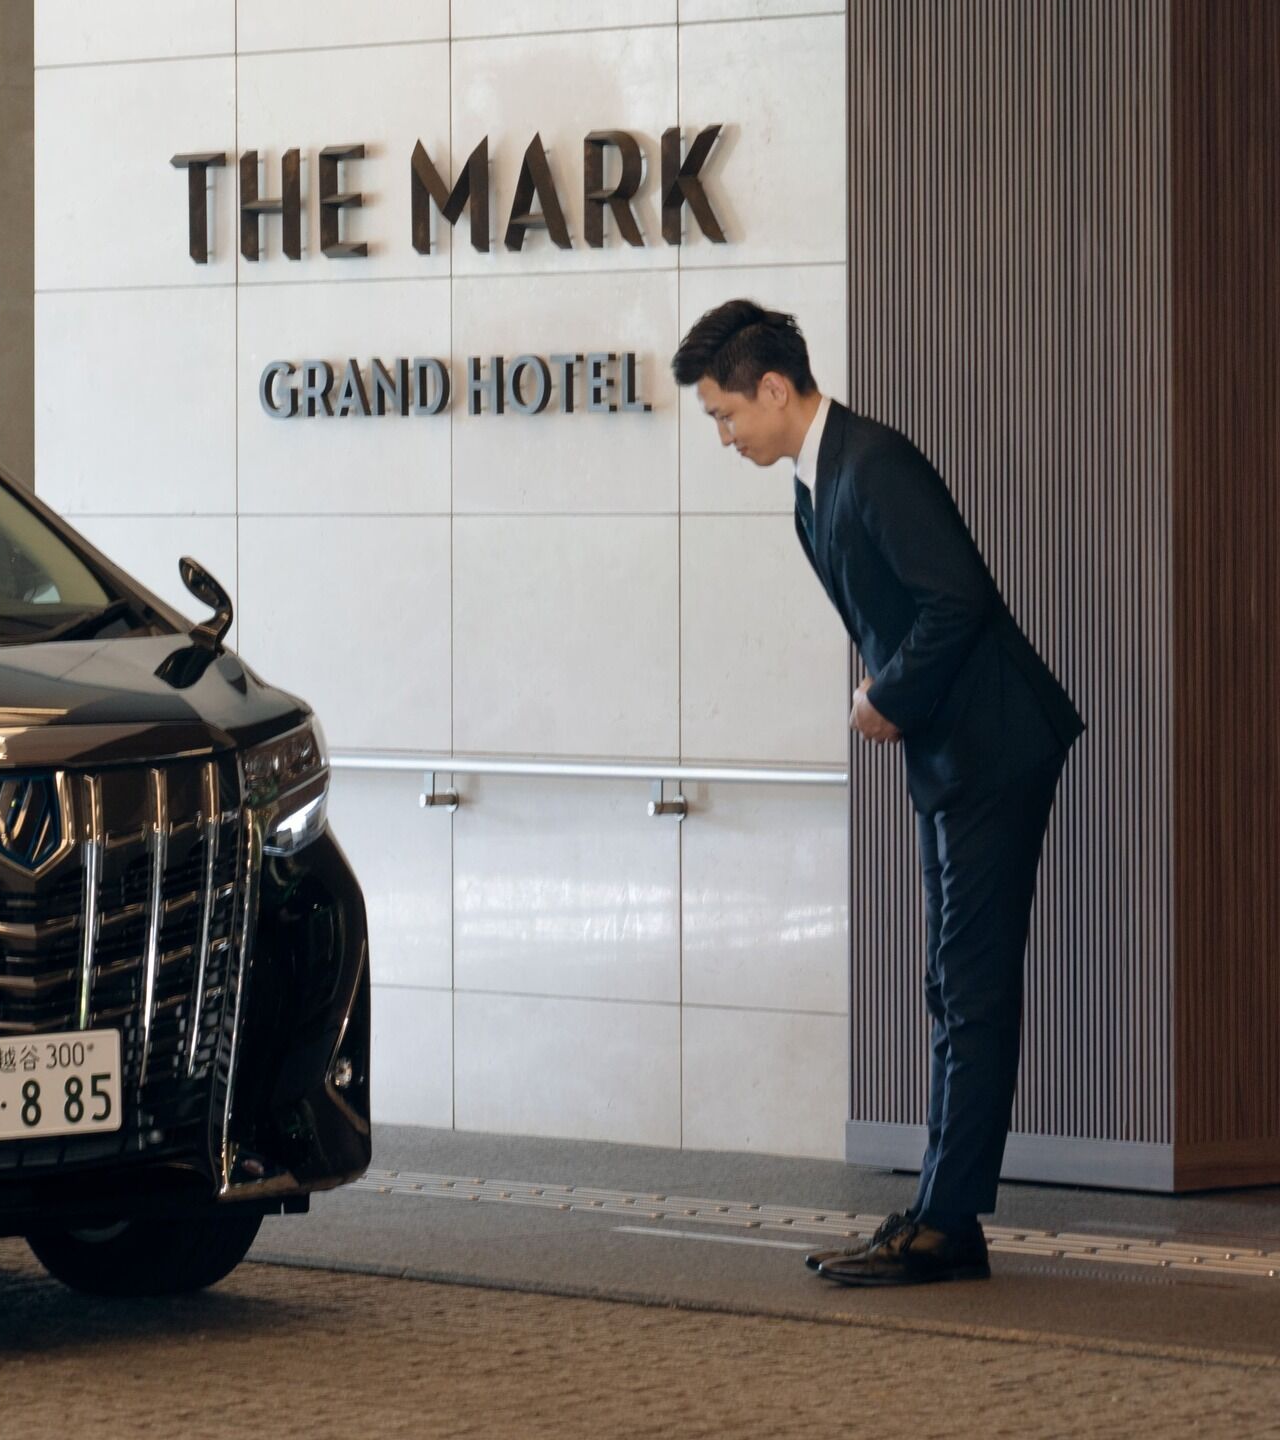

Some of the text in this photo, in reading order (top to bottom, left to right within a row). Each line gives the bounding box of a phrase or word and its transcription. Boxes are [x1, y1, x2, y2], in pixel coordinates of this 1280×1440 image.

[170, 124, 727, 264] THE MARK
[259, 352, 652, 418] GRAND HOTEL
[45, 1042, 85, 1069] 300
